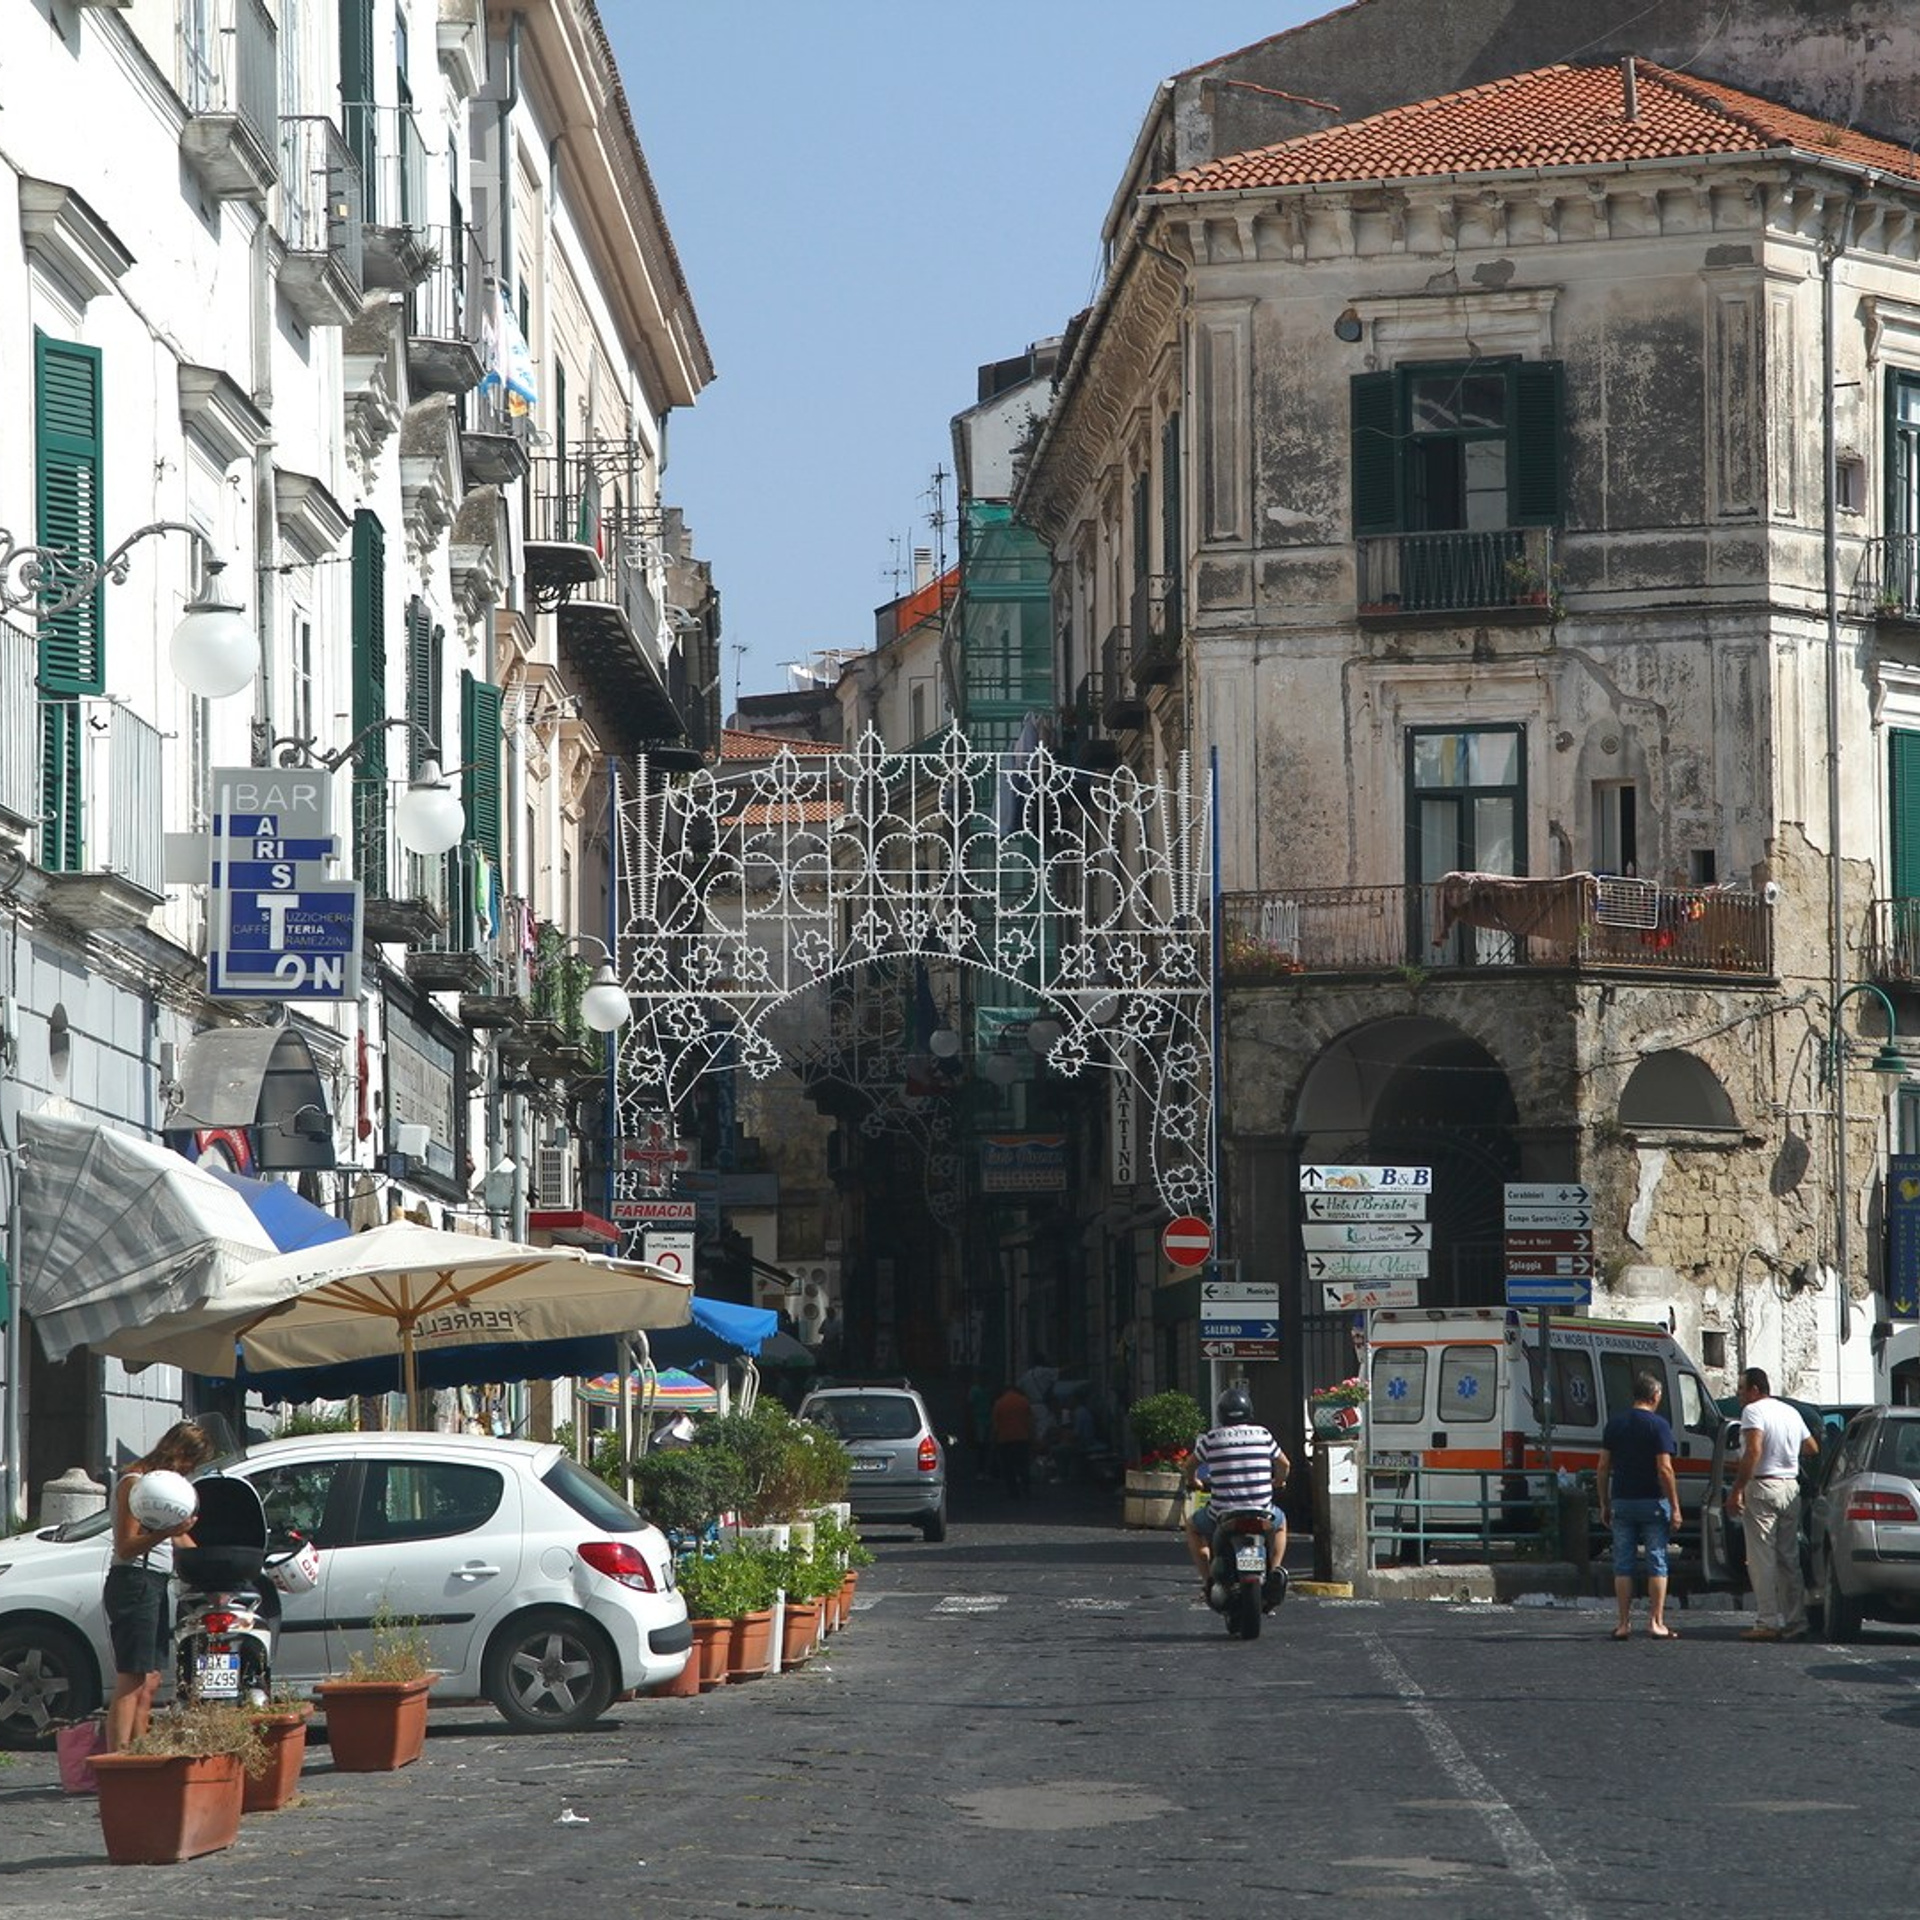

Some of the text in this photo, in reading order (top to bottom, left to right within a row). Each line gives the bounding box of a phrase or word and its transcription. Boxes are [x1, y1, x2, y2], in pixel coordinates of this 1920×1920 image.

[236, 784, 317, 812] BAR
[1507, 1190, 1544, 1199] Carabinieri
[1326, 1195, 1407, 1210] Hotel Bristol
[613, 1204, 693, 1217] FARMACIA
[1334, 1255, 1421, 1273] Hotel Vietri
[1509, 1260, 1542, 1271] Spiaggia
[1247, 1287, 1276, 1296] Municipio
[1204, 1325, 1242, 1335] SALERNO
[1564, 1333, 1593, 1347] MOBILE
